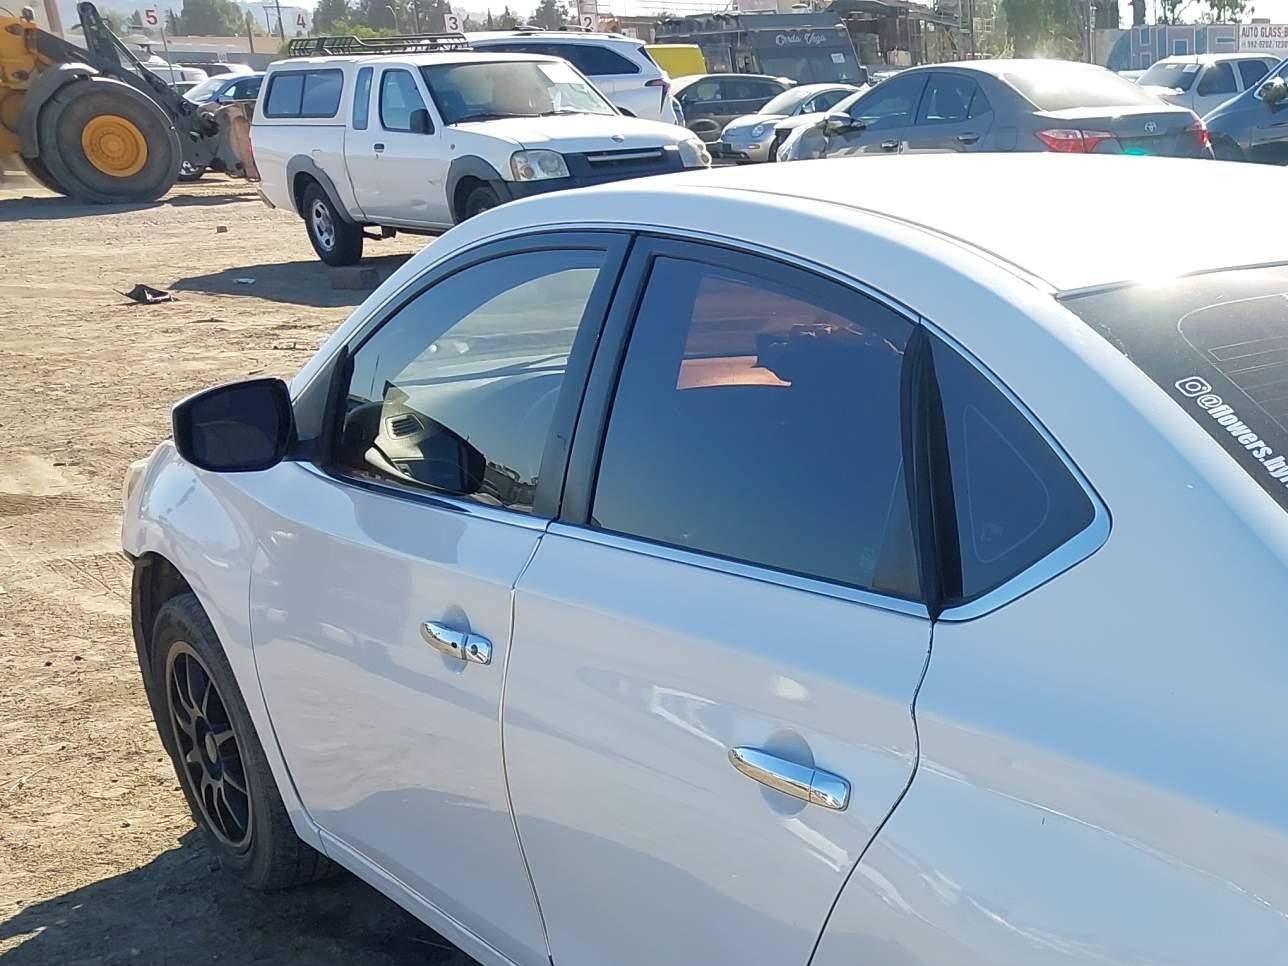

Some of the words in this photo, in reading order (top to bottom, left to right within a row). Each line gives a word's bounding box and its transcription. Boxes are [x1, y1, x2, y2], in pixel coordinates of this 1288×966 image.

[145, 10, 158, 26] 5
[296, 14, 307, 29] 4
[449, 17, 459, 31] 3
[583, 17, 593, 29] 2
[1241, 26, 1259, 38] AUTO
